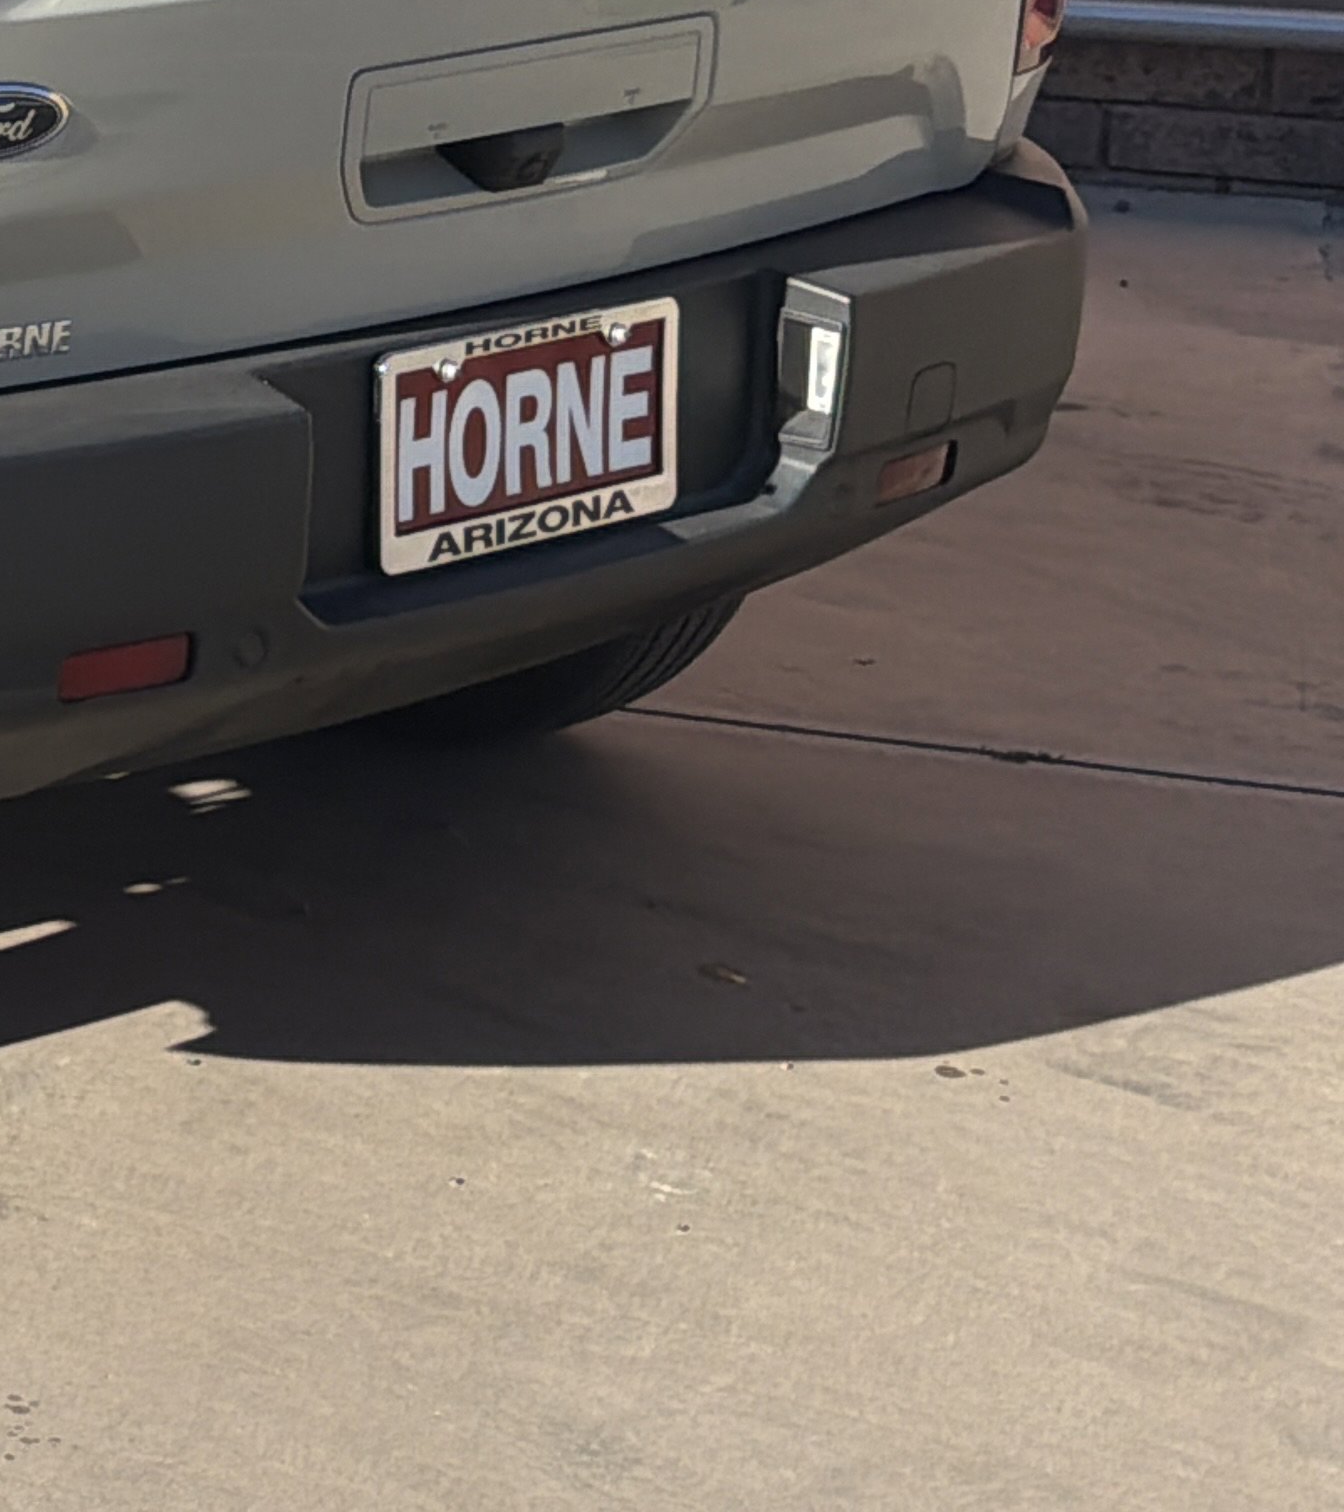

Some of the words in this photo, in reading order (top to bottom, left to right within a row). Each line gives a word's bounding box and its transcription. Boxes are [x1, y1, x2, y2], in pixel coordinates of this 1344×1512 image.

[464, 314, 602, 355] HORNE
[398, 345, 654, 523] HORNE
[427, 489, 635, 563] ARIZONA
